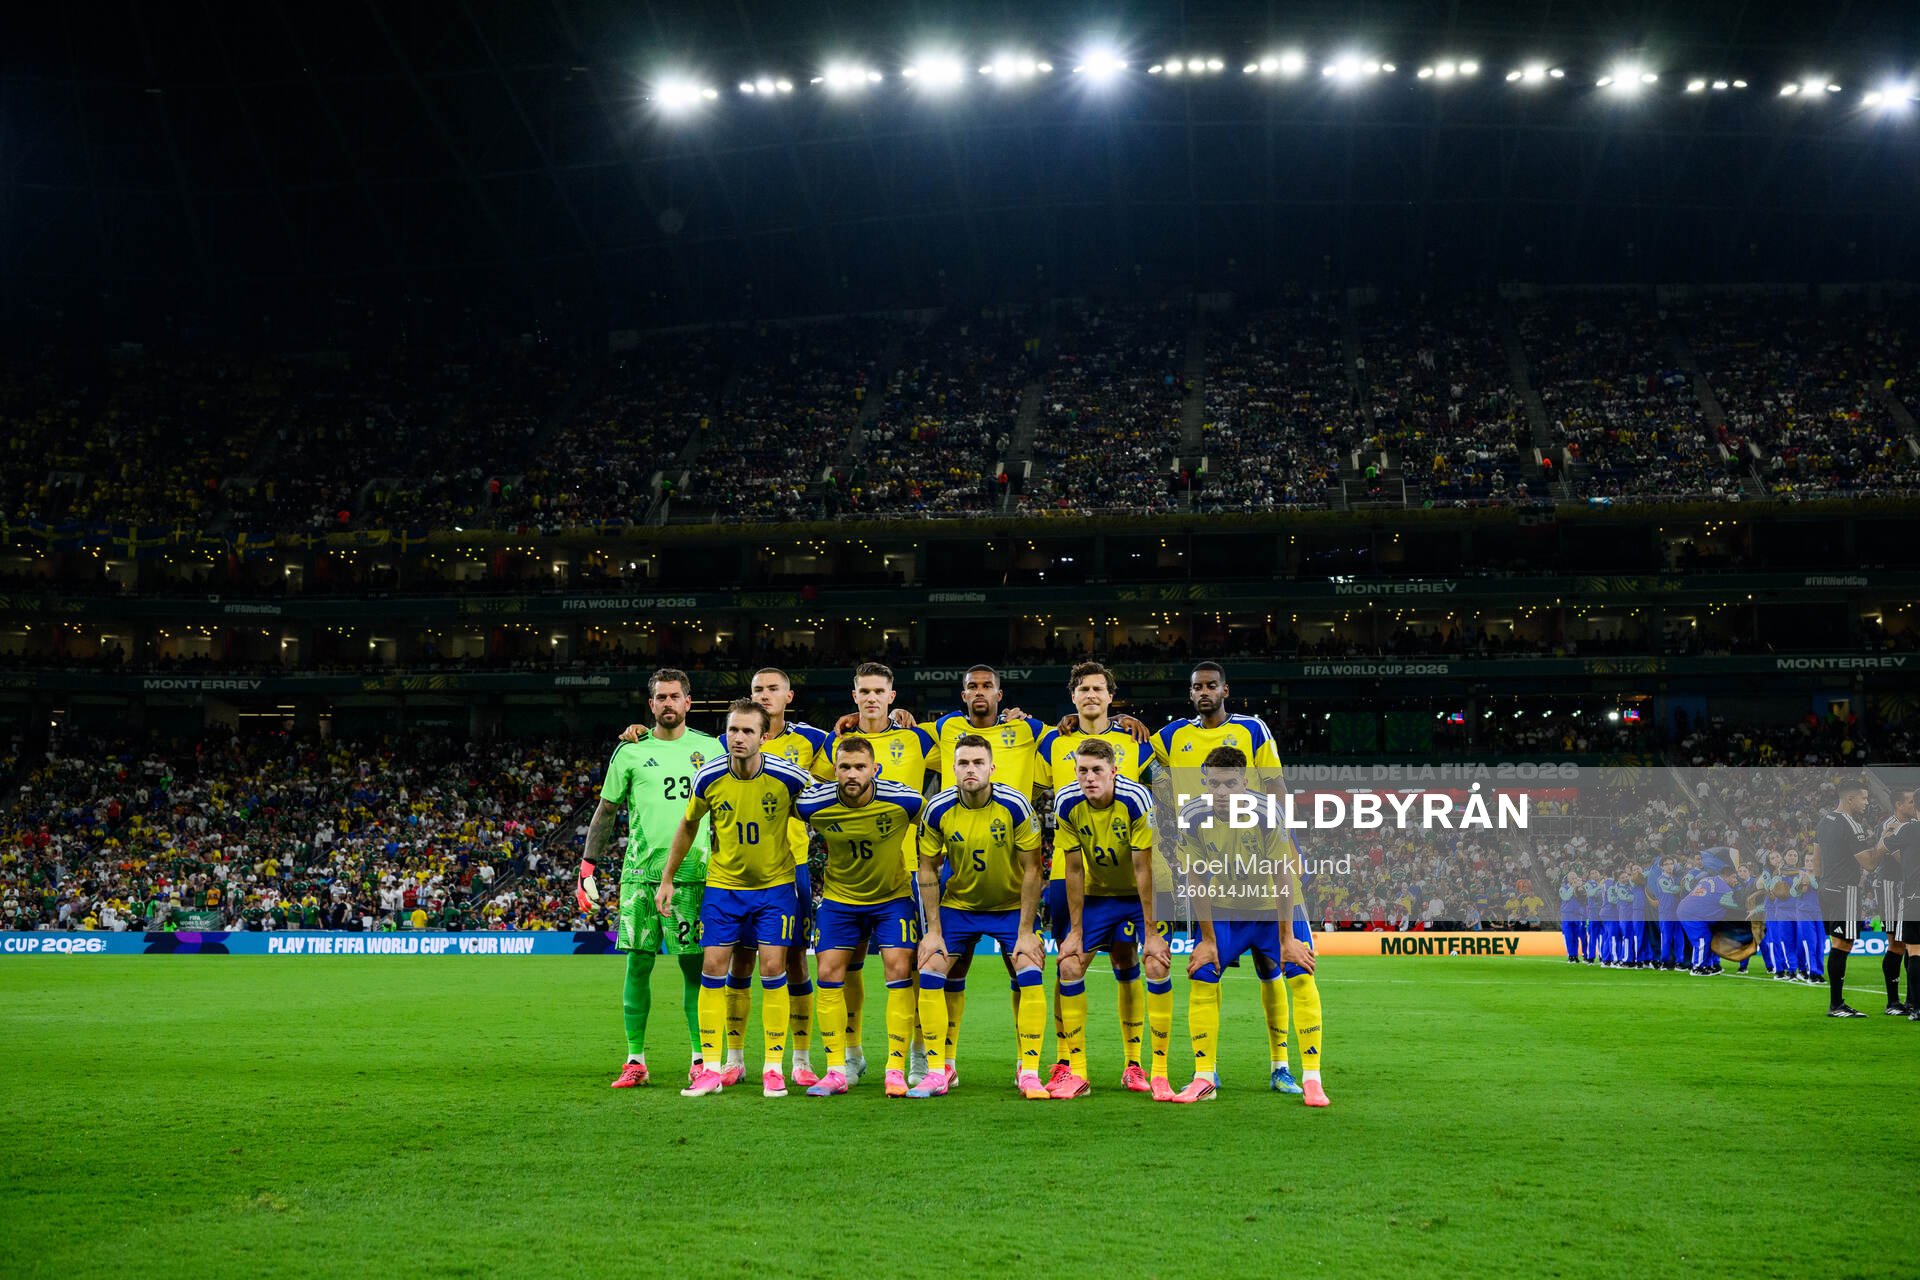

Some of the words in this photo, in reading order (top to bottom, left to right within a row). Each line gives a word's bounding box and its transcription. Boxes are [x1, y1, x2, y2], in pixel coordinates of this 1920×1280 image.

[1335, 582, 1457, 594] MONTERREY
[1805, 576, 1868, 587] #FIFAWorldCup
[562, 599, 586, 609] FIFA
[588, 599, 630, 608] WORLD
[632, 598, 655, 607] CUP
[656, 597, 697, 607] 2026
[1303, 664, 1330, 675] FIFA
[1332, 664, 1377, 675] WORLD
[1378, 664, 1403, 674] CUP
[1404, 663, 1449, 674] 2026
[1776, 656, 1907, 669] MONTERREY
[143, 679, 262, 690] MONTERREY
[1284, 764, 1367, 781] UNDIAL
[1373, 763, 1401, 781] DE
[1406, 763, 1435, 780] LA
[1440, 762, 1491, 780] FIFA
[1496, 761, 1580, 780] 2026
[663, 776, 691, 800] 23
[736, 821, 760, 845] 10
[848, 839, 874, 860] 16
[1094, 846, 1119, 866] 21
[972, 849, 986, 872] 5
[899, 918, 919, 944] 16
[4, 937, 39, 952] CUP
[268, 937, 305, 954] PLAY
[307, 937, 333, 954] THE
[334, 937, 365, 954] FIFA
[367, 937, 418, 954] WORLD
[500, 937, 534, 954] WAY
[1381, 937, 1520, 955] MONTERREY
